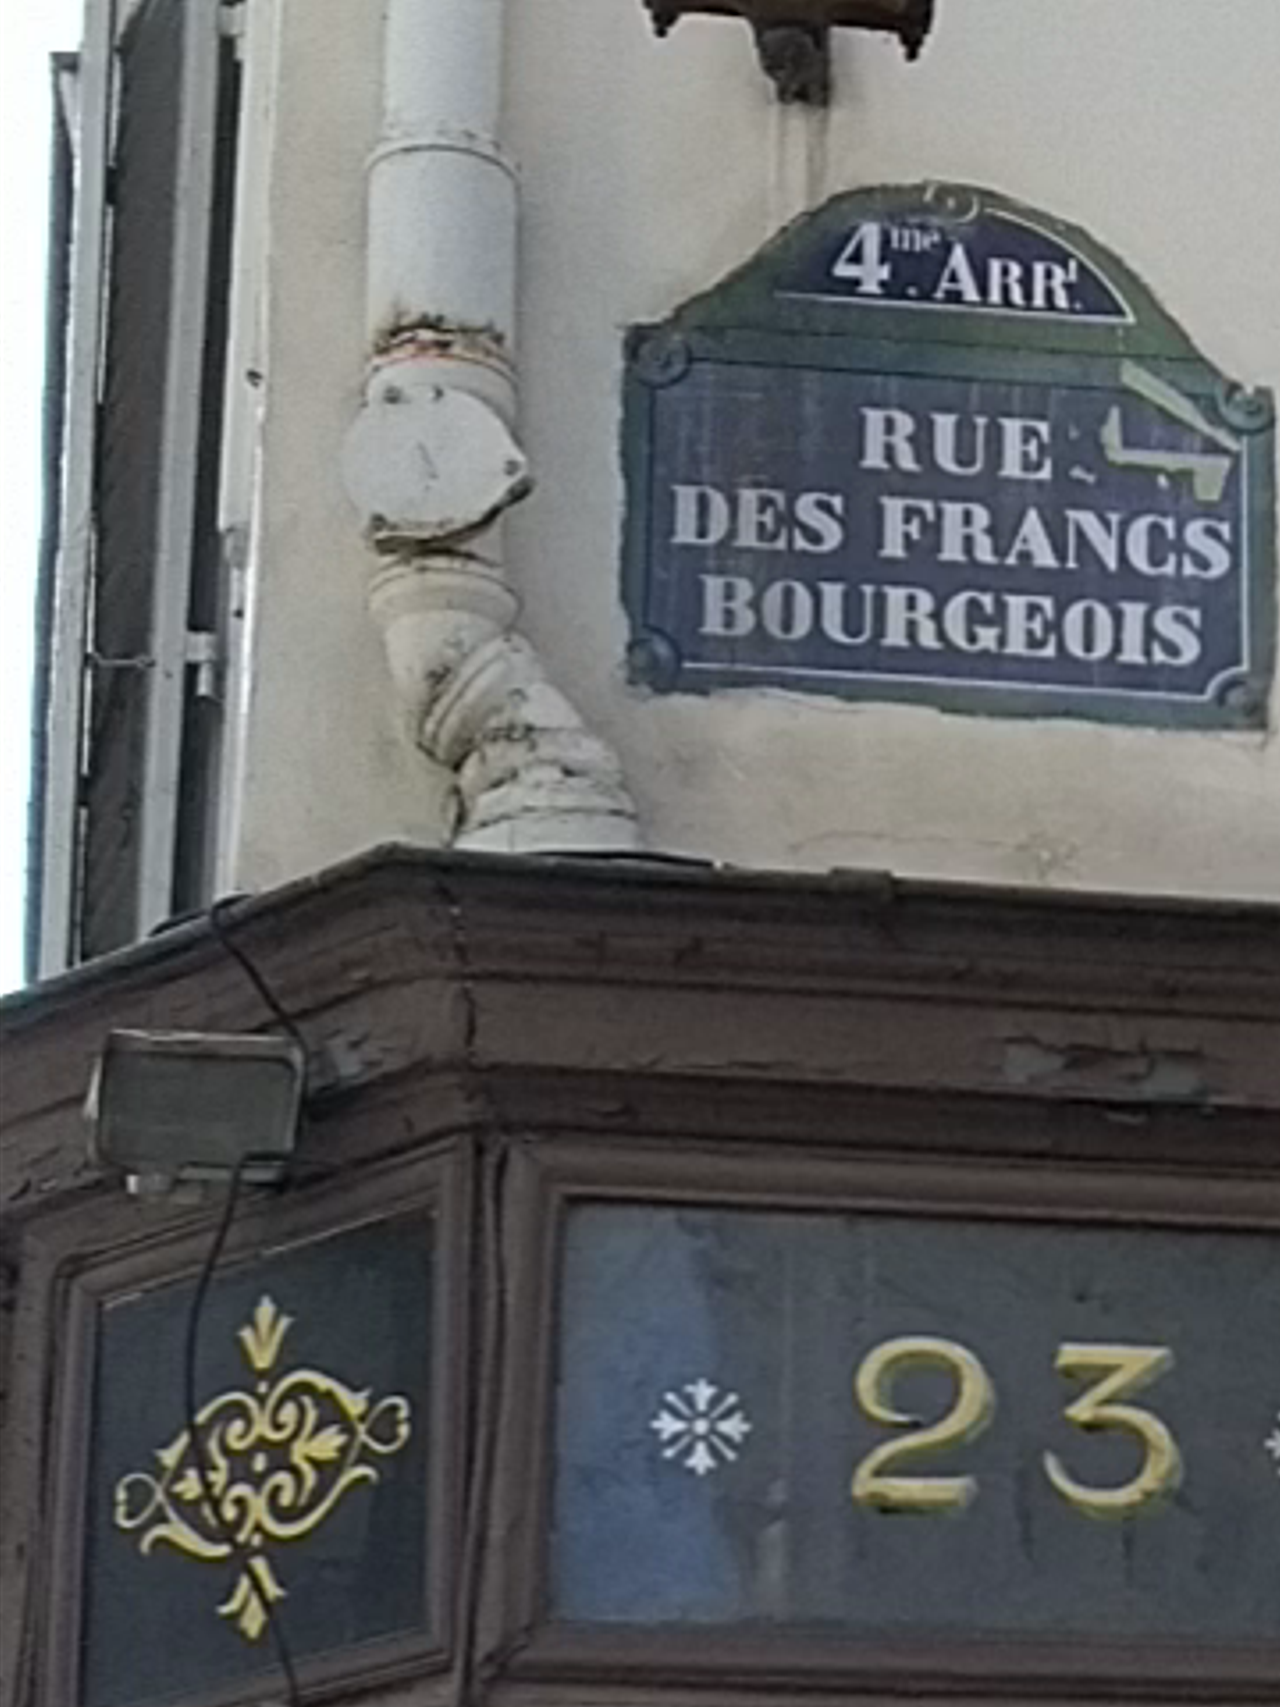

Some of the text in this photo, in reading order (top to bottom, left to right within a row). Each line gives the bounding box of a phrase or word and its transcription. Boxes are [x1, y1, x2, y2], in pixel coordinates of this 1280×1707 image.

[860, 406, 1052, 481] RUE
[670, 484, 1232, 579] DES FRANCS
[699, 575, 1202, 666] BOURGEOIS
[853, 1336, 1185, 1525] 23
